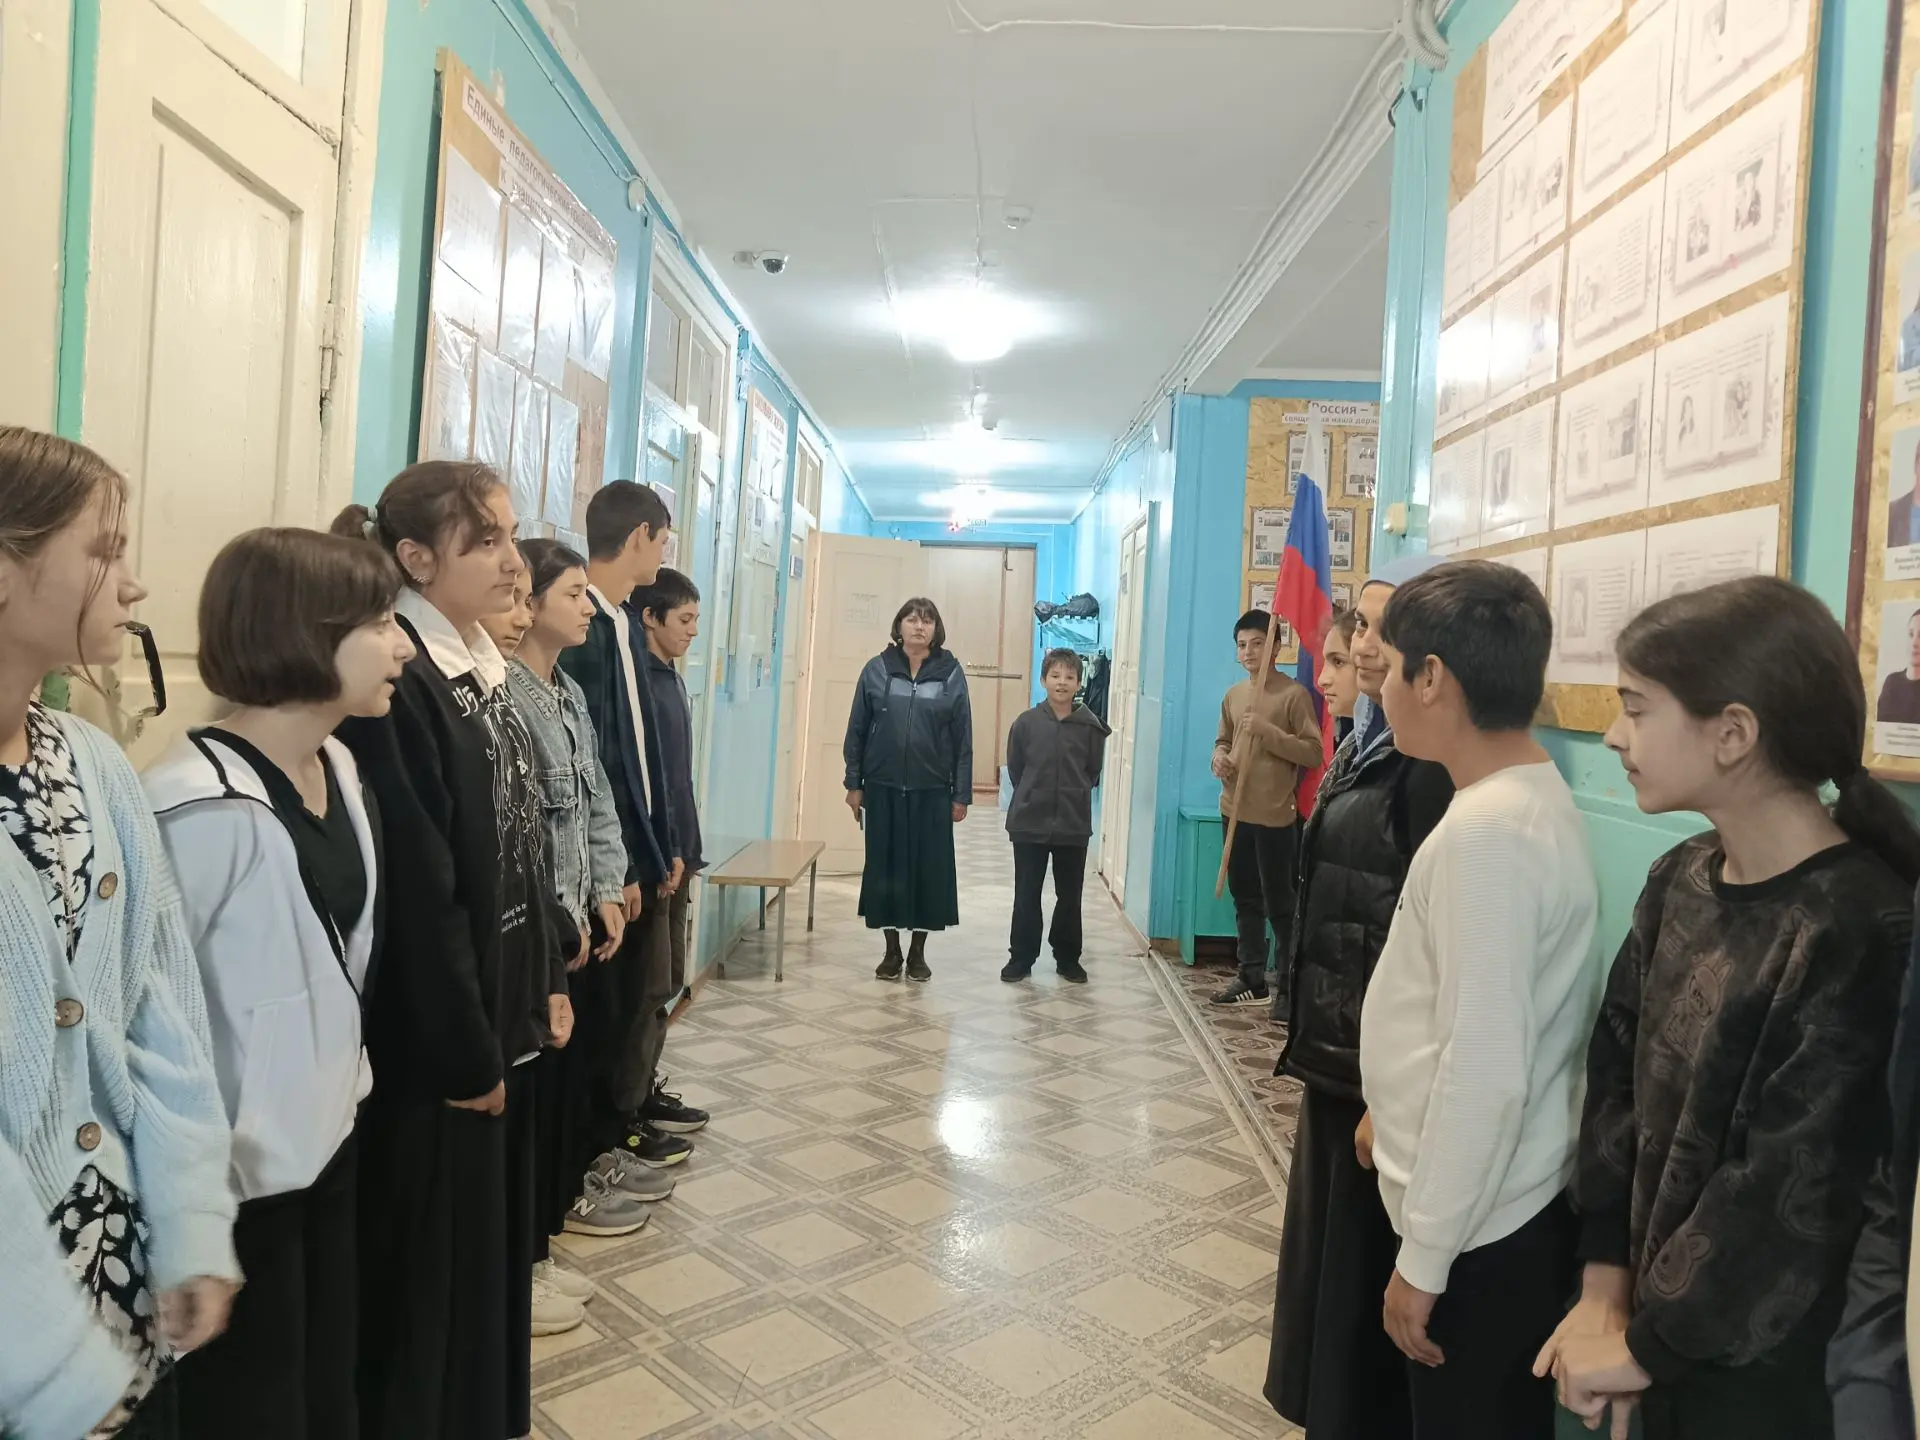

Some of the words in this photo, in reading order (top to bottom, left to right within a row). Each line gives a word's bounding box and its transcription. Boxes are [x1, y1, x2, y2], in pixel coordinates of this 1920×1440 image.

[466, 84, 505, 144] Единые
[604, 1168, 627, 1186] N
[573, 1197, 596, 1218] N
